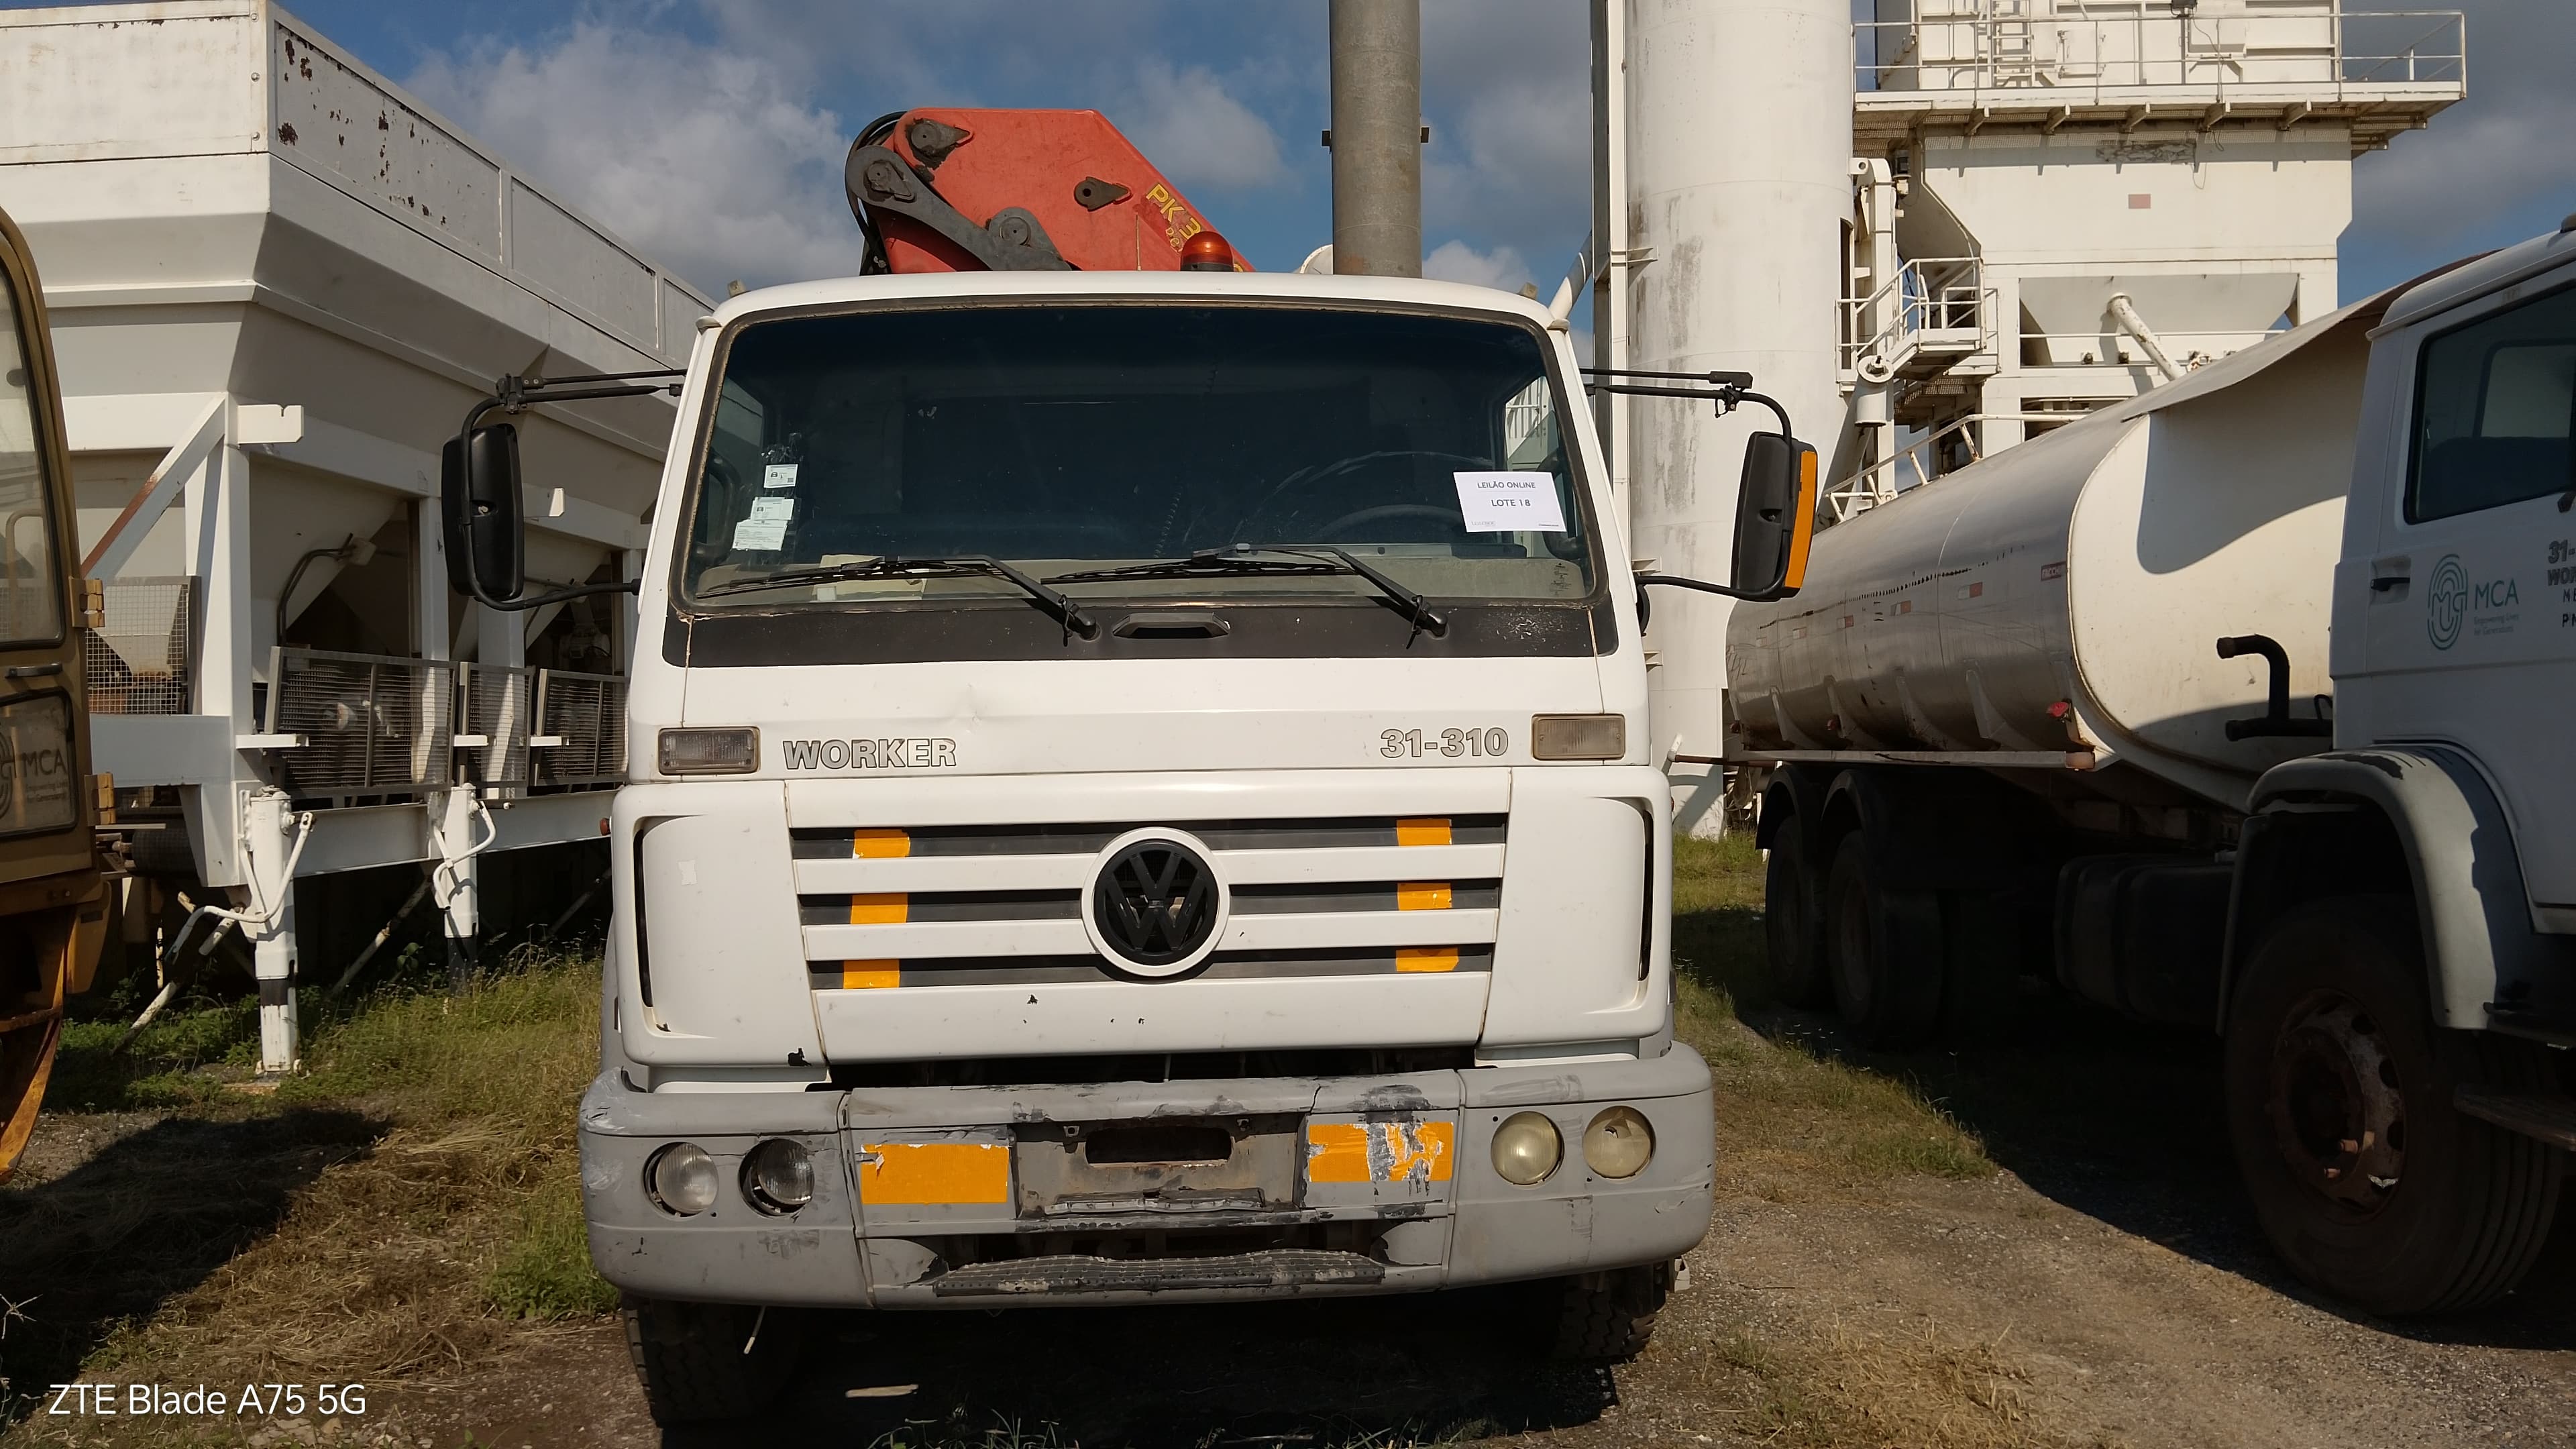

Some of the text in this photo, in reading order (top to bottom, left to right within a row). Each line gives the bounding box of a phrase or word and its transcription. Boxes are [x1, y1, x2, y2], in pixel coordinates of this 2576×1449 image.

[1146, 183, 1185, 223] PK
[1477, 480, 1505, 489] LEILÃO
[1491, 499, 1517, 507] LOTE
[2474, 577, 2520, 610] MCA
[782, 738, 957, 771] WORKER
[1380, 727, 1509, 759] 31-310
[23, 748, 67, 778] MCA
